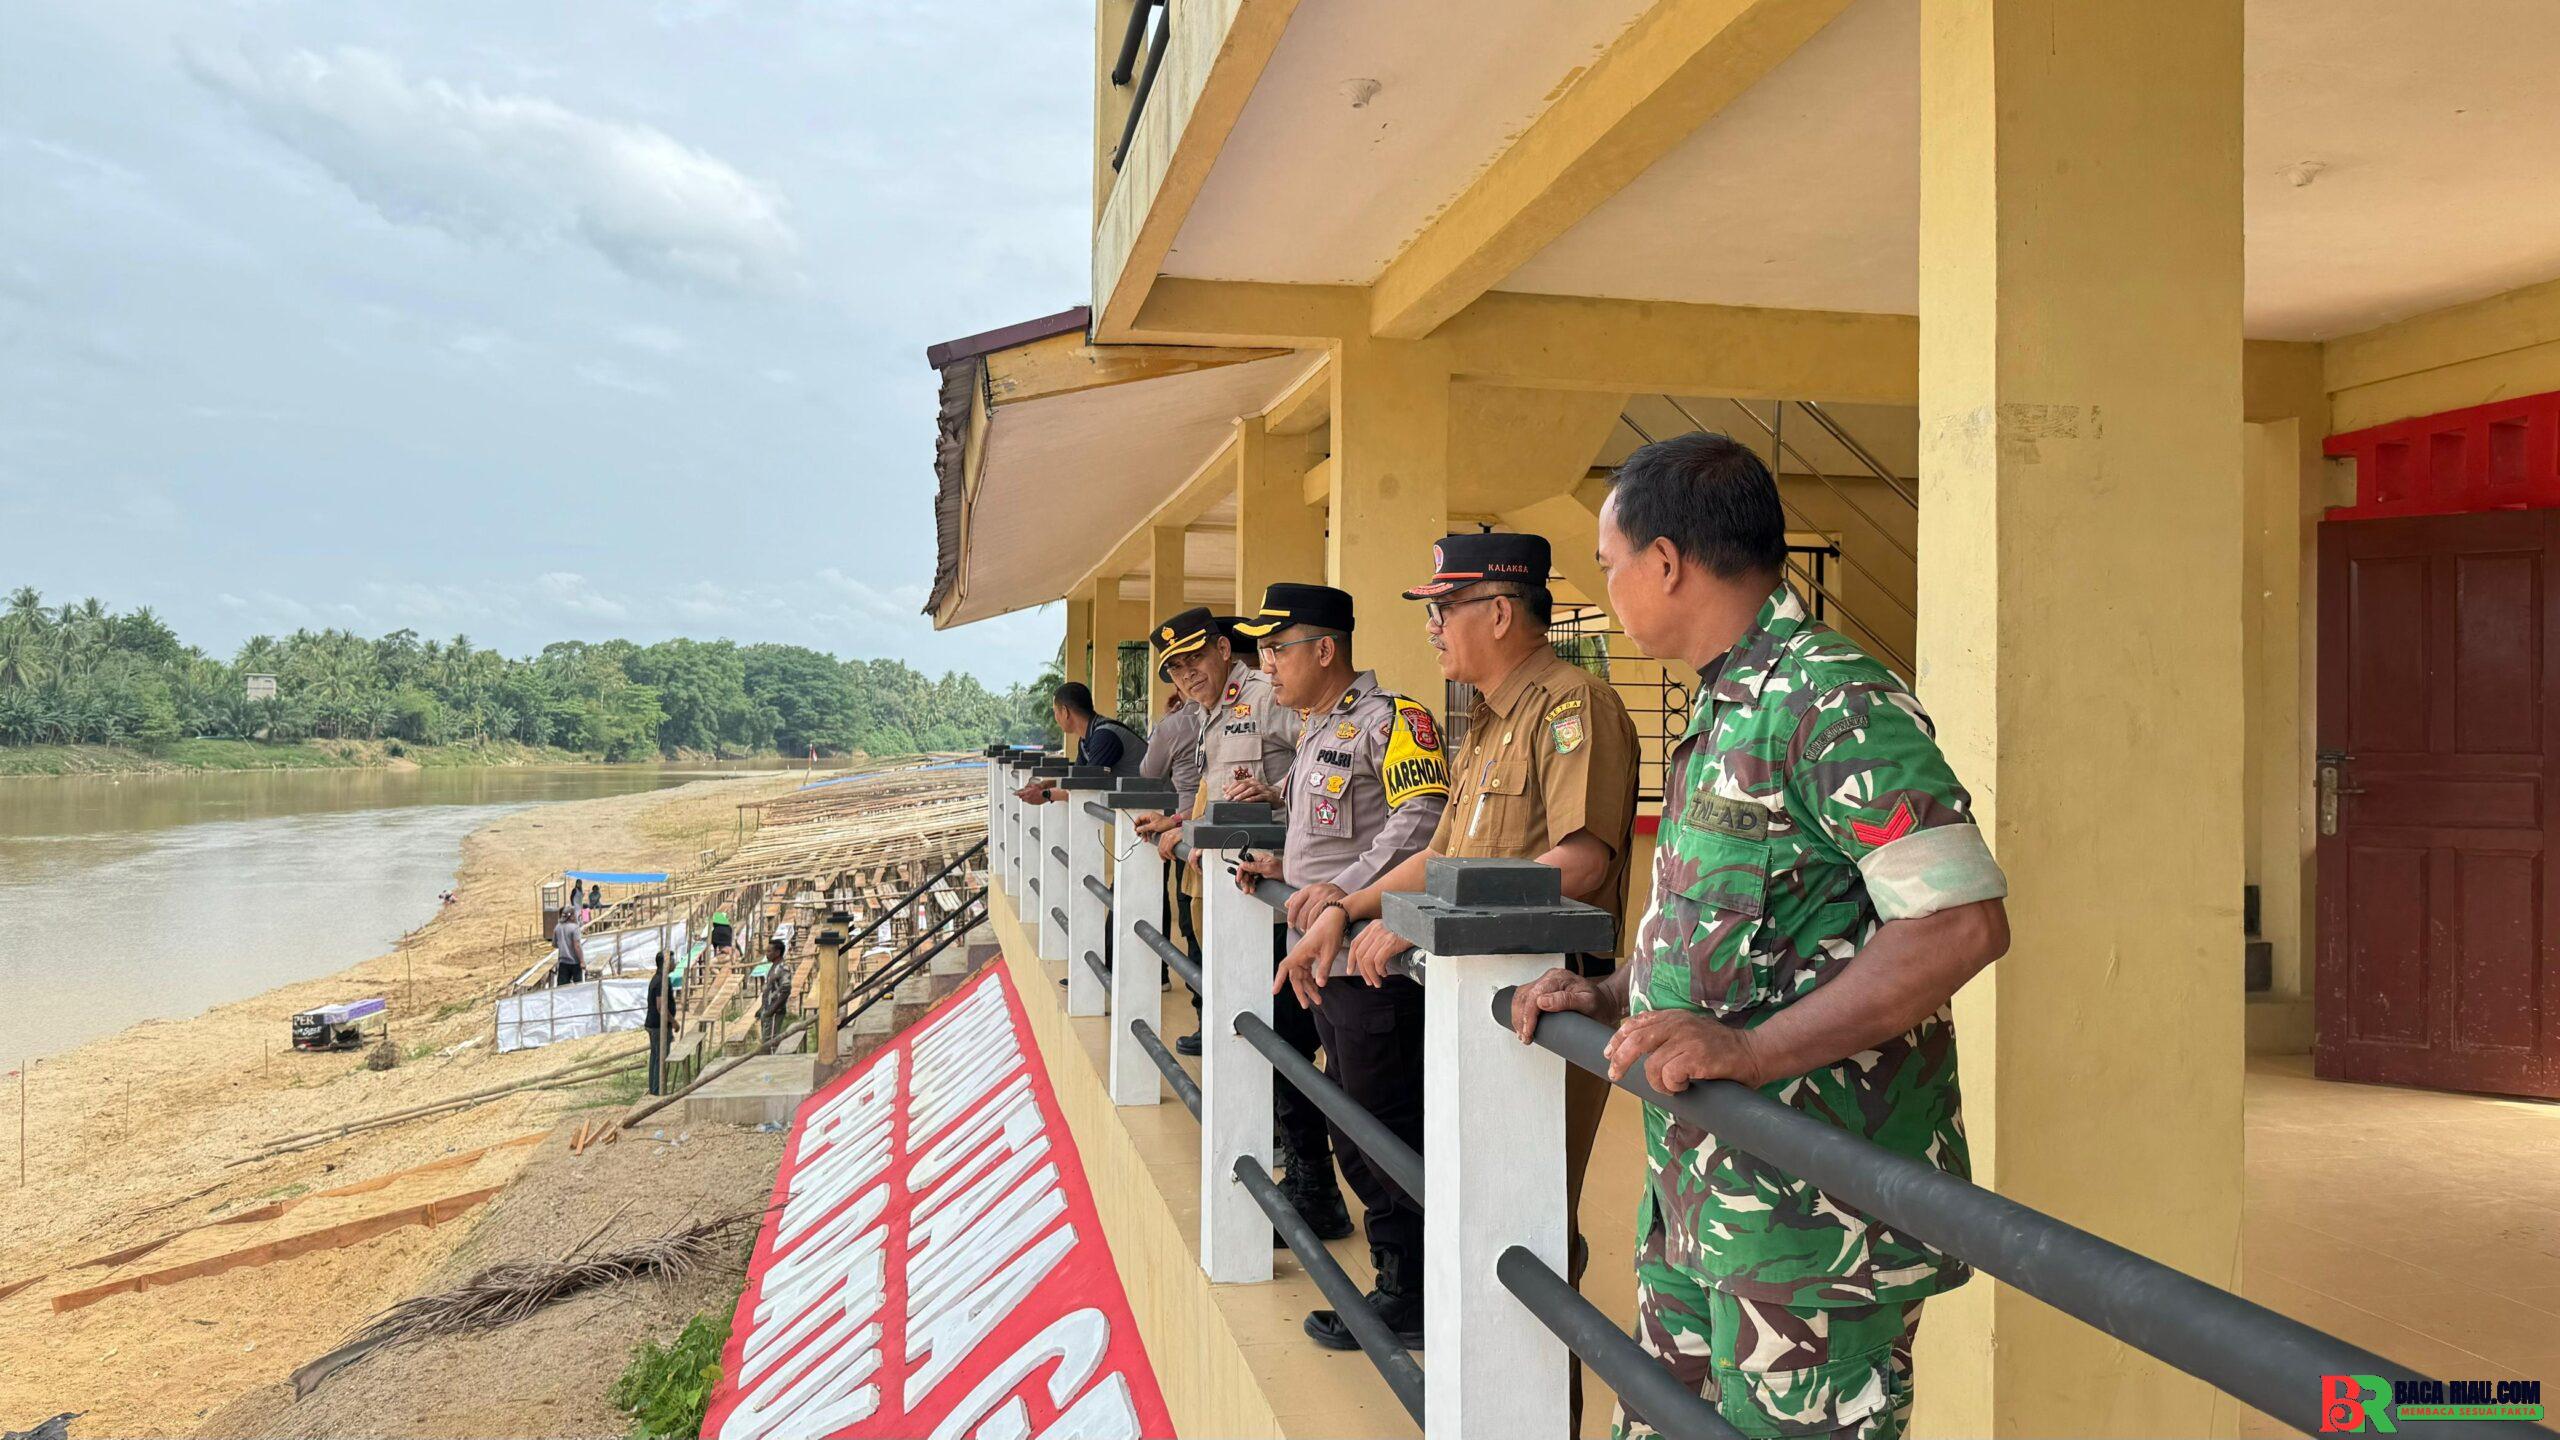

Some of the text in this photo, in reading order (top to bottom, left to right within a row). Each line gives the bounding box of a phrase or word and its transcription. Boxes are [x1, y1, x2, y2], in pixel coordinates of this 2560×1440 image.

[1488, 563, 1529, 573] KALAKSA
[1224, 721, 1256, 735] POLRI
[1316, 749, 1352, 768] POLRI
[1385, 757, 1451, 797] KARENDAL
[1688, 798, 1758, 831] TNI-AD
[906, 972, 1026, 1155] TRIBUN
[772, 1049, 900, 1254] TEPIAN
[903, 1073, 1080, 1415] UTAMA
